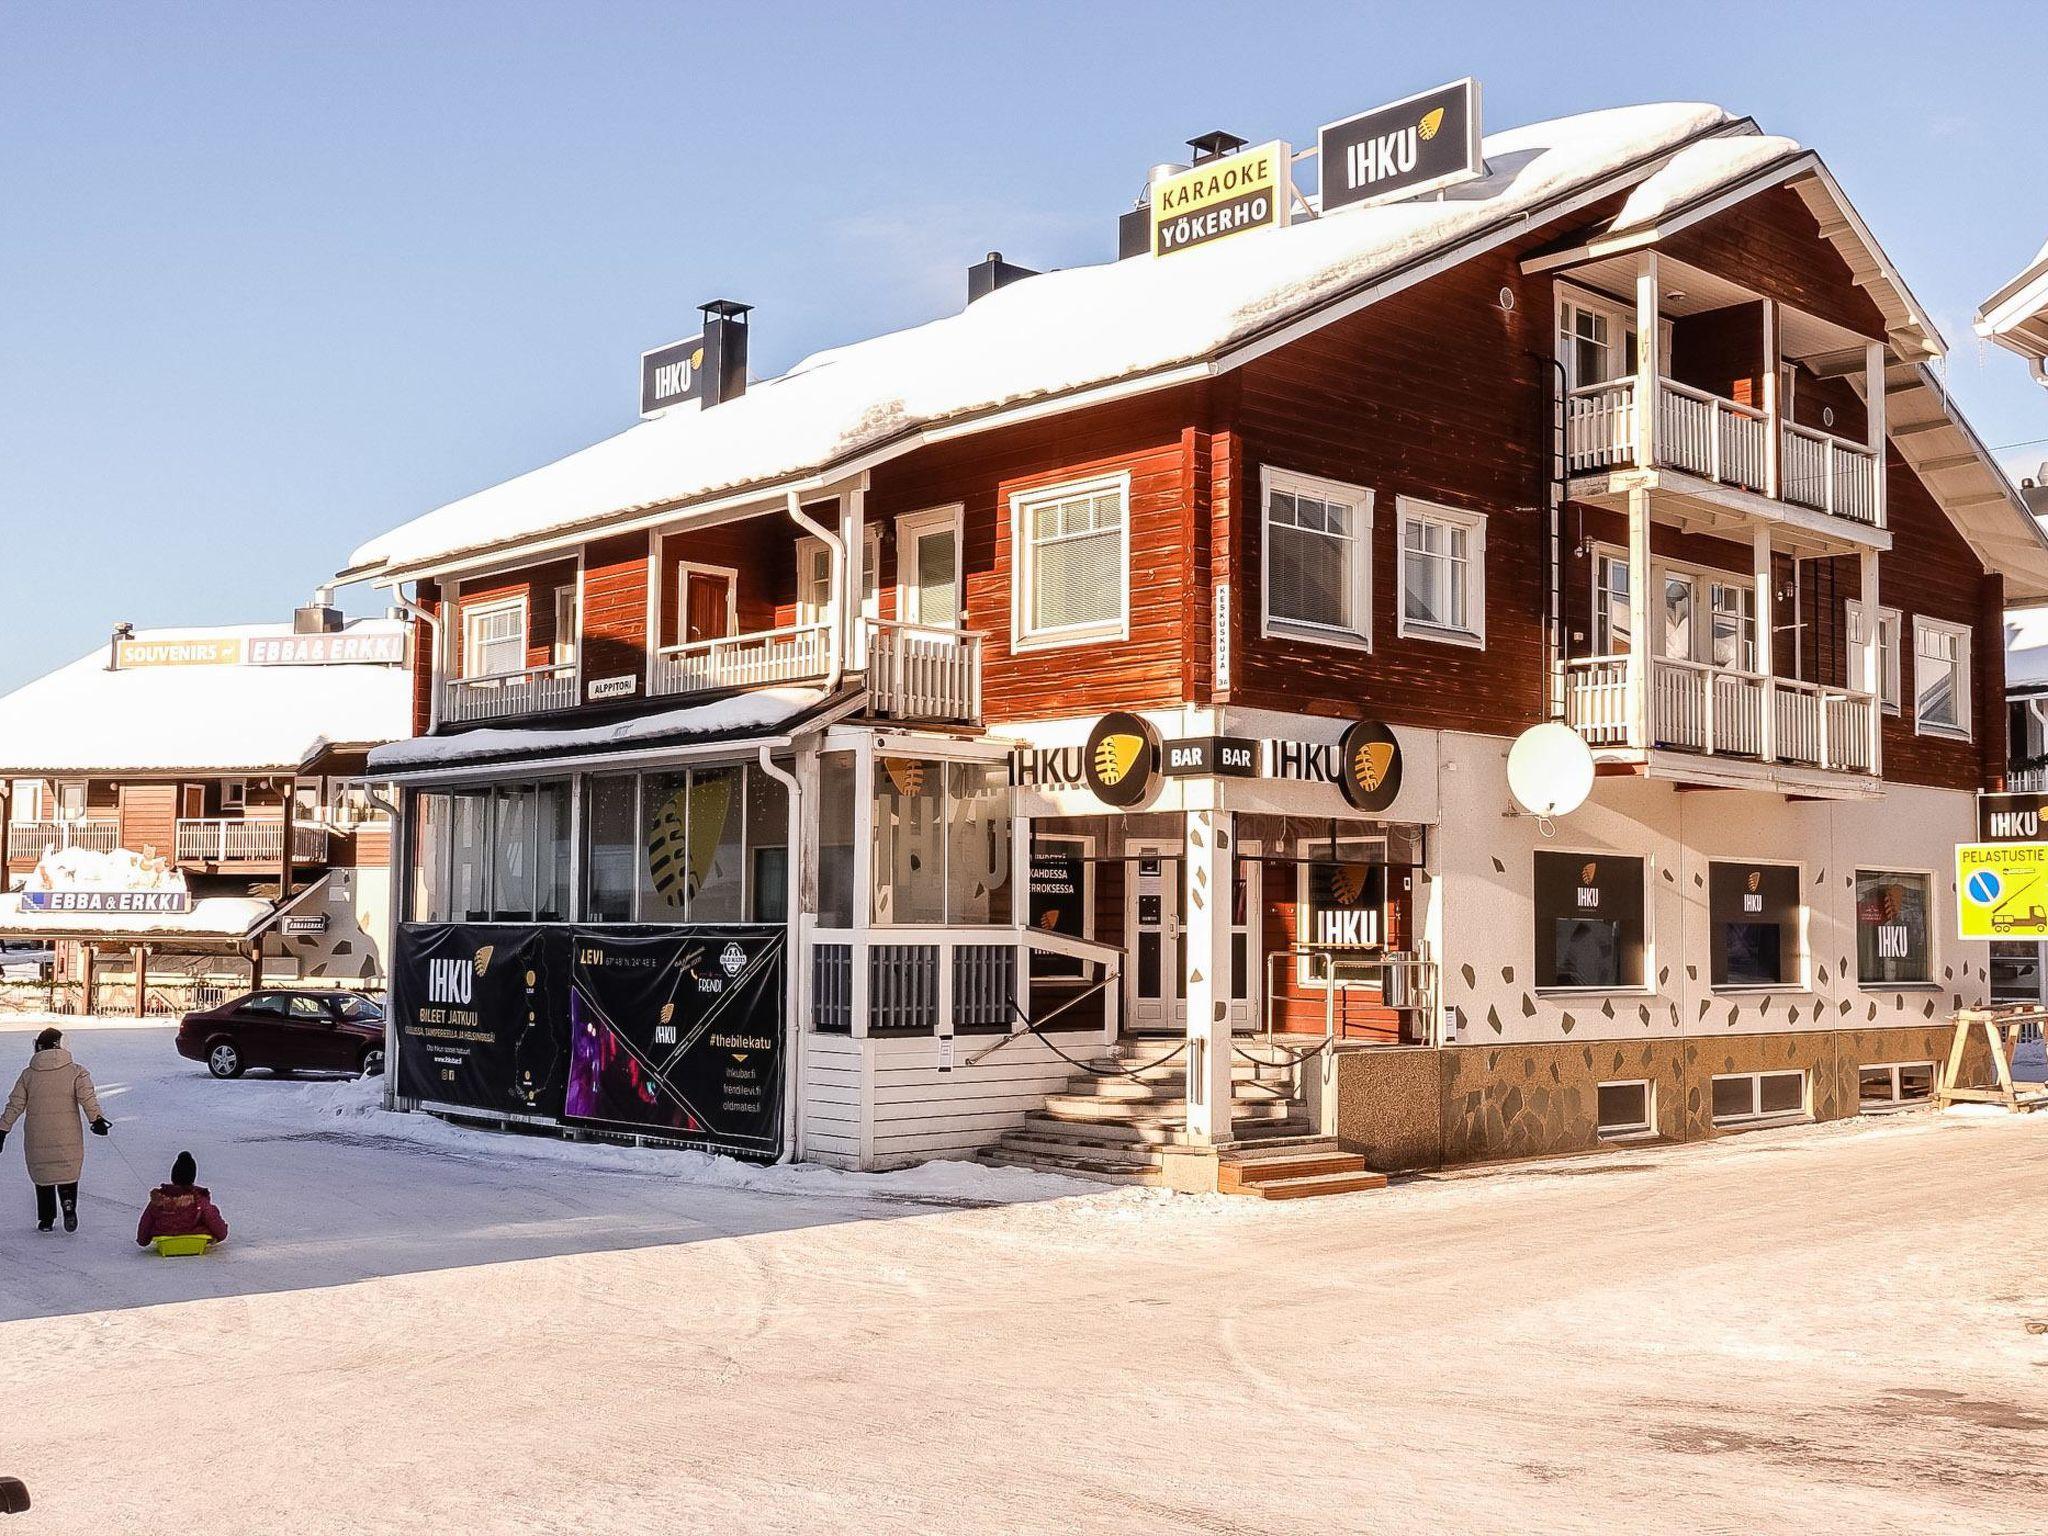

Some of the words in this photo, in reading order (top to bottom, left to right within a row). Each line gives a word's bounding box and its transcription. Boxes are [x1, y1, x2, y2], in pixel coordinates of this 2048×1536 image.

[1348, 126, 1417, 189] IHKU
[1162, 159, 1268, 211] KARAOKE
[1162, 197, 1268, 248] YÖKERHO
[655, 359, 691, 399] IHKU
[125, 645, 216, 661] SOUVENIRS
[253, 640, 309, 662] EBBA
[311, 640, 324, 661] &
[329, 637, 400, 659] ERKKI
[595, 681, 632, 694] ALPPITORI
[1008, 746, 1083, 786] IHKU
[1171, 747, 1202, 767] BAR
[1222, 747, 1250, 767] BAR
[1271, 739, 1341, 783] IHKU
[1991, 812, 2037, 837] IHKU
[1963, 849, 2045, 863] PELASTUSTIE
[50, 893, 101, 910] EBBA
[106, 896, 116, 910] &
[119, 893, 180, 910] ERKKI
[1577, 888, 1598, 907] IHKU
[1744, 894, 1762, 912] IHKU
[1318, 911, 1377, 950] IHKU
[1878, 926, 1908, 957] IHKU
[580, 949, 603, 965] LEVI
[429, 958, 472, 1004] IHKU
[698, 979, 722, 993] FRENDI
[420, 1008, 446, 1023] BILEET
[448, 1011, 478, 1027] JATKUU
[656, 1026, 676, 1044] IHKU
[710, 1033, 771, 1049] #thebilekatu
